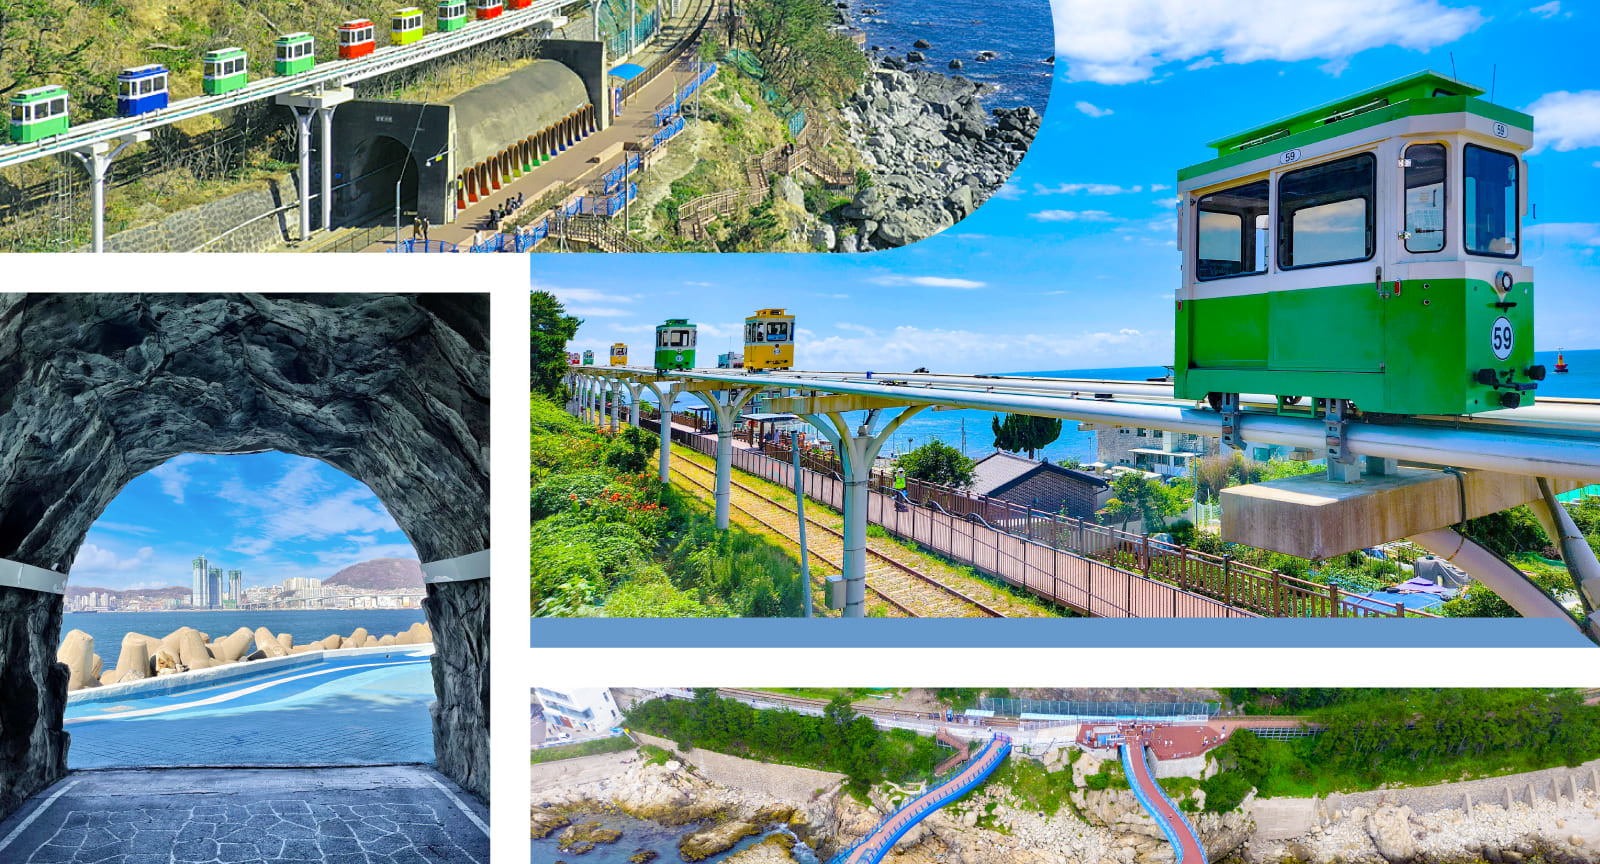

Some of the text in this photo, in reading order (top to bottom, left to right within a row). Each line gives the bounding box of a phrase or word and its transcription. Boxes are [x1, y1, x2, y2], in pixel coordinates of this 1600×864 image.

[1497, 125, 1504, 135] 59
[1285, 151, 1295, 162] 59
[1494, 327, 1511, 350] 59
